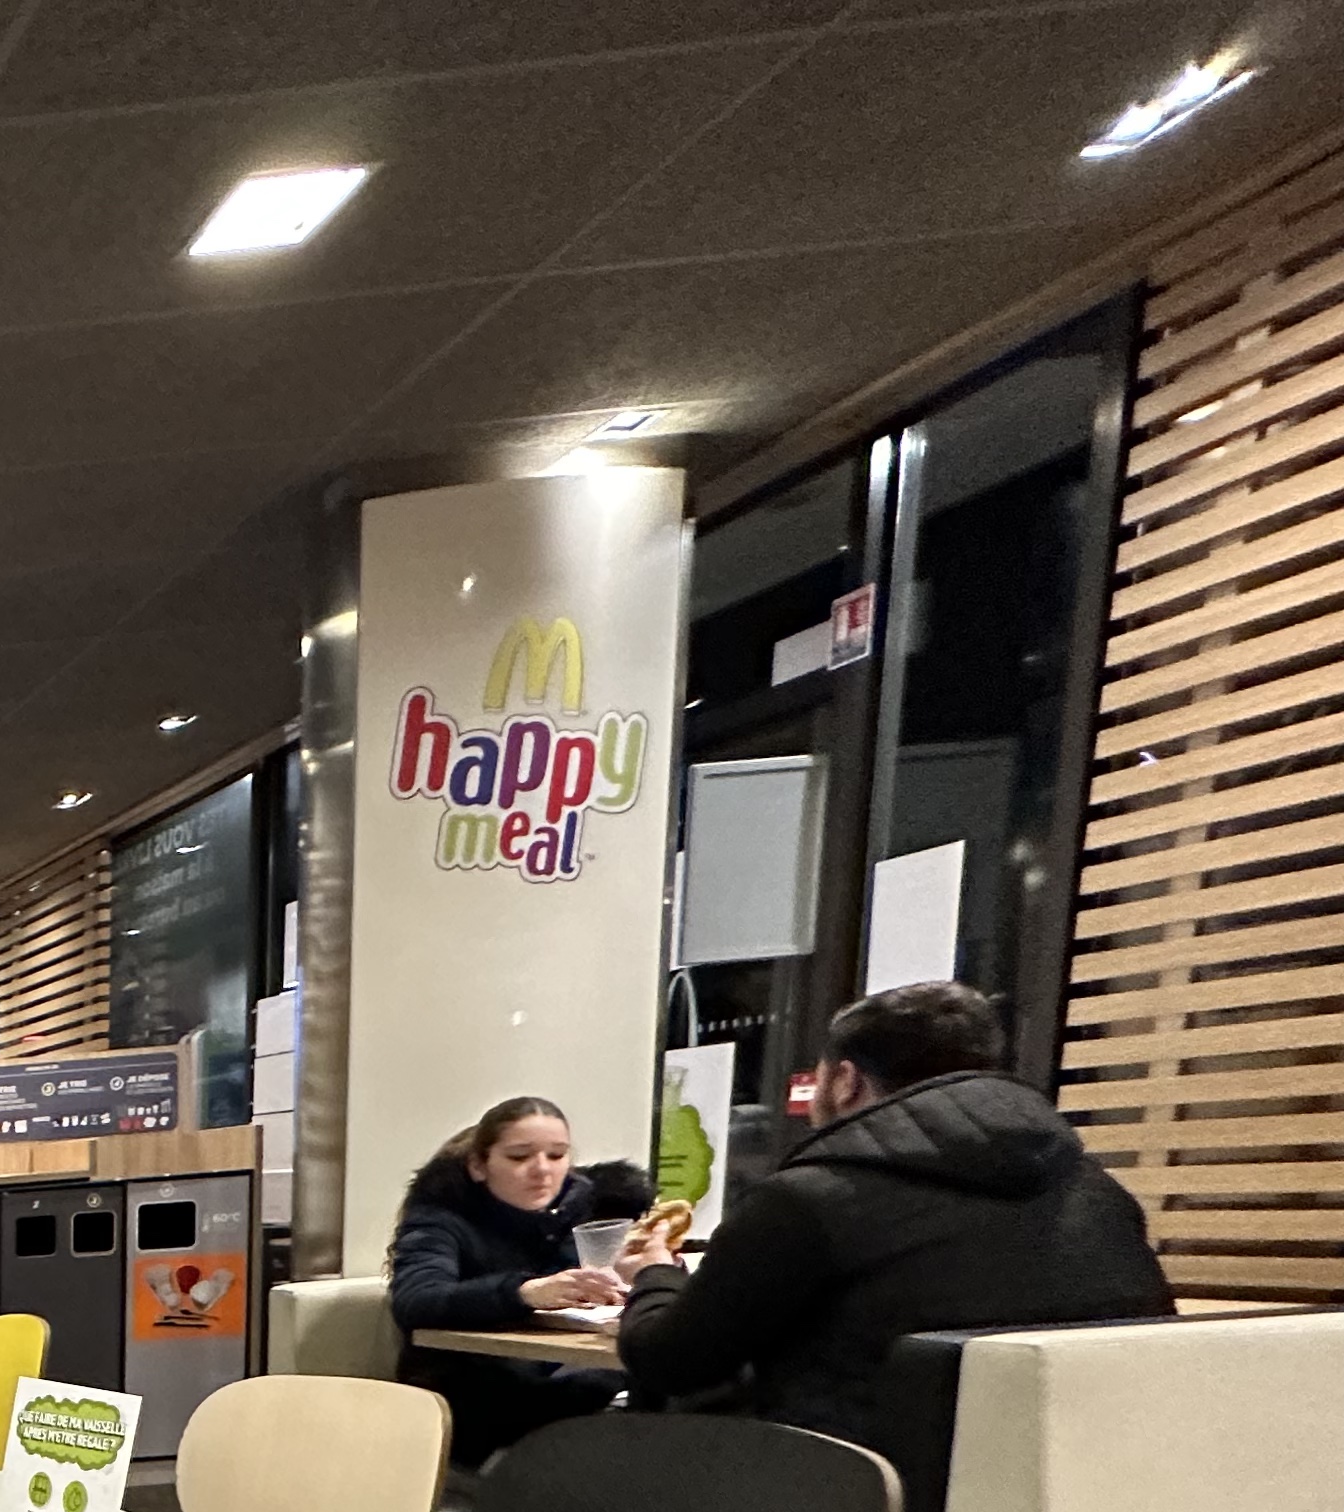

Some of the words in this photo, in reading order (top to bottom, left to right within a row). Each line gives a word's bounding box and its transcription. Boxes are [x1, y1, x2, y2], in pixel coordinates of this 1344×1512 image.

[396, 692, 644, 826] happy
[442, 809, 580, 878] meal
[35, 1411, 57, 1426] FAIRE
[57, 1414, 69, 1428] DE
[69, 1416, 83, 1430] MA
[83, 1418, 127, 1436] VAISSELLE
